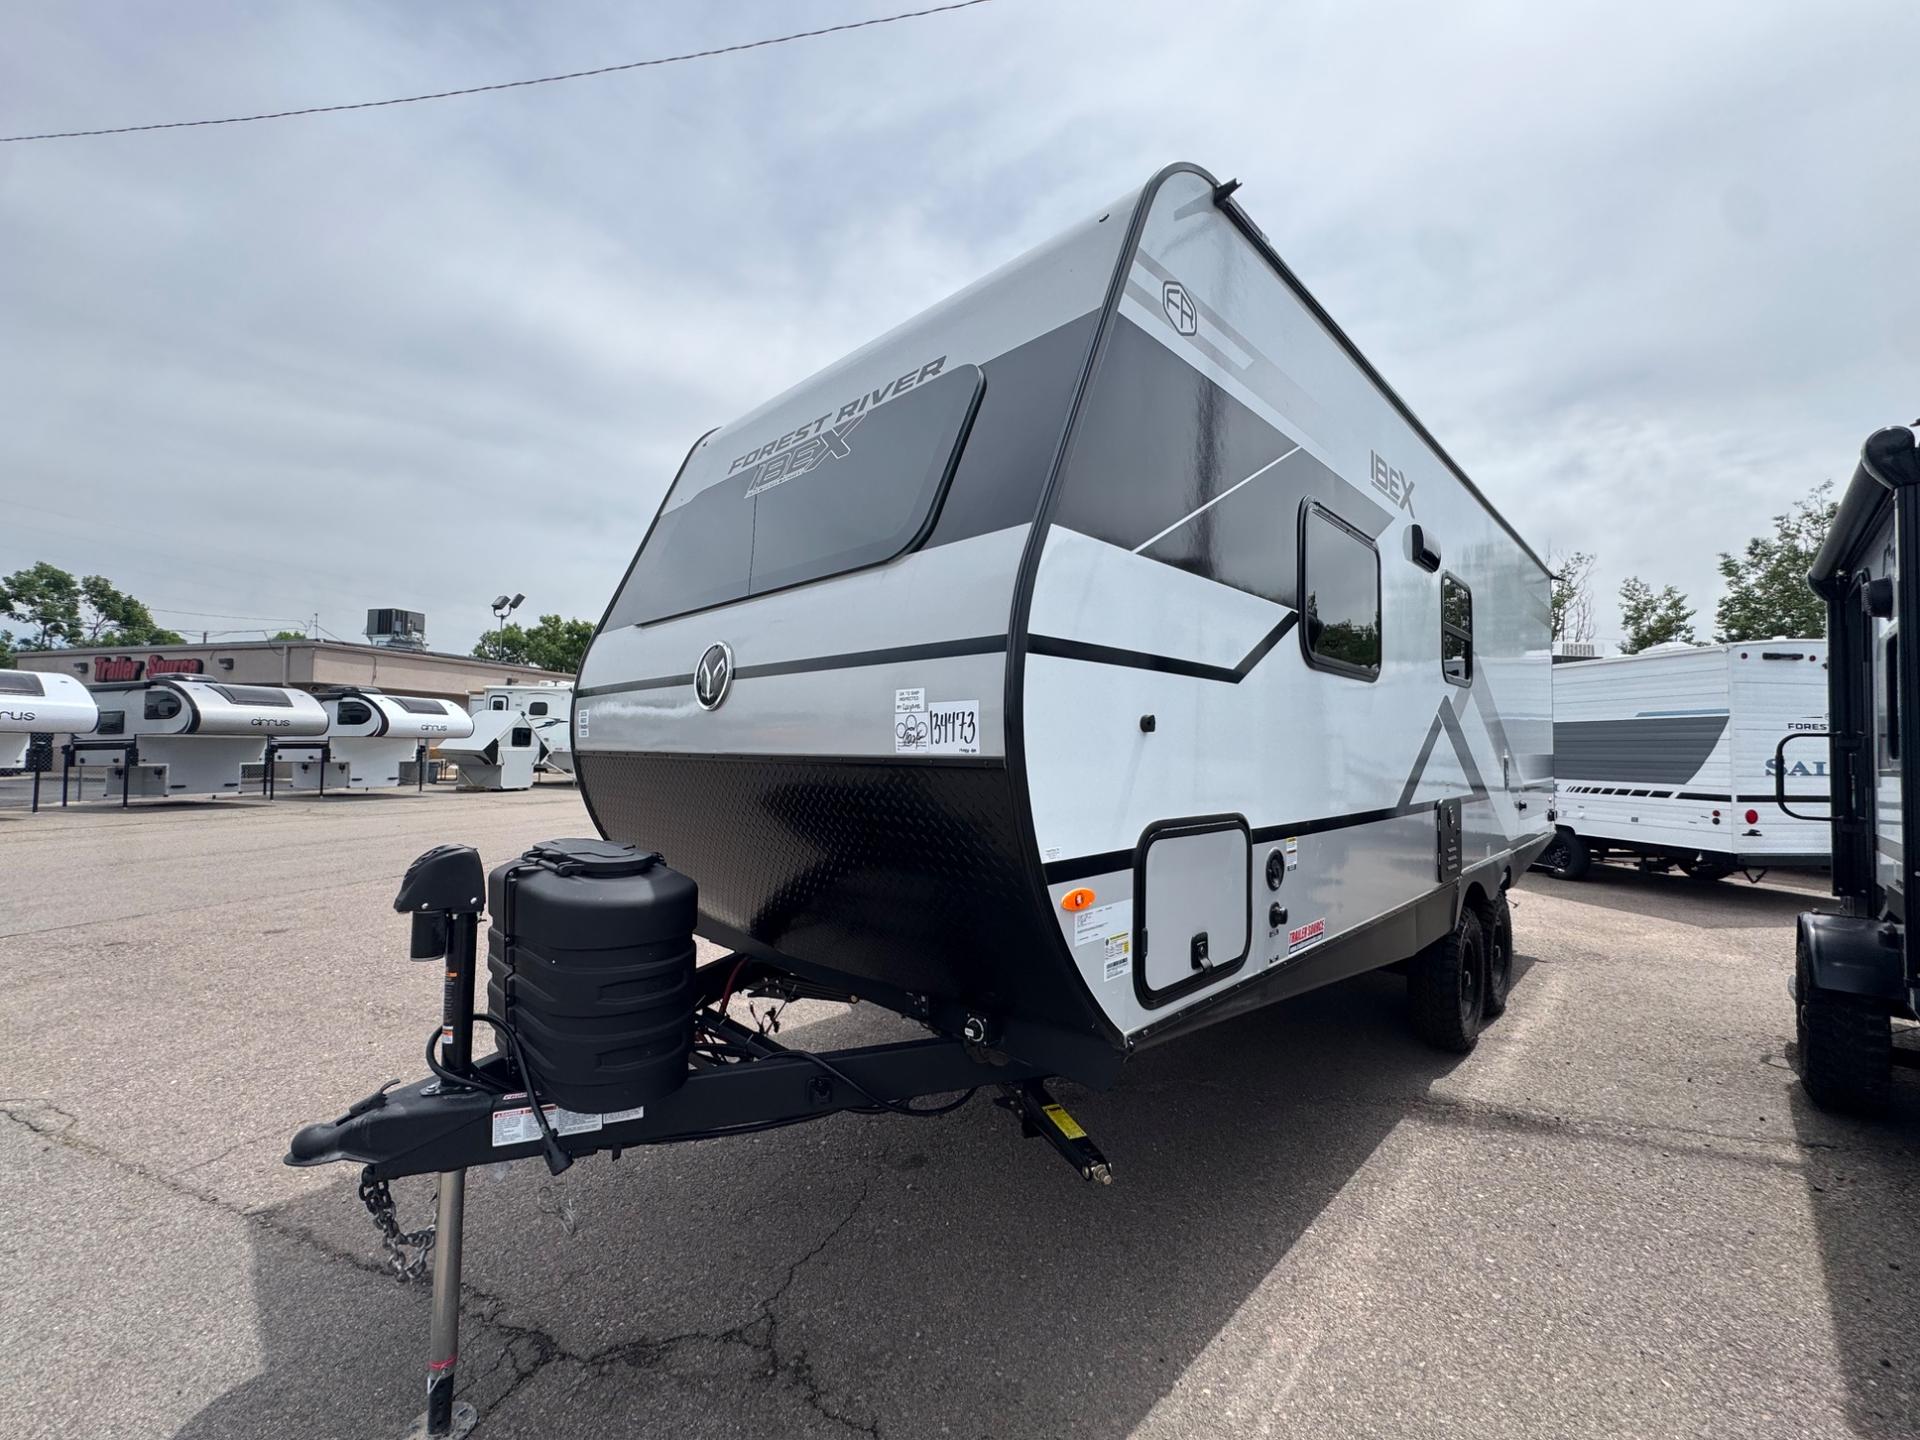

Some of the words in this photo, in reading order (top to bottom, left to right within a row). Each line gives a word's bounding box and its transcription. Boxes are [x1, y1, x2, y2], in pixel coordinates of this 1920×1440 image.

[728, 412, 833, 475] FOREST
[835, 355, 948, 425] RIVER
[745, 411, 867, 498] IBEX
[1370, 449, 1415, 519] IBEX
[95, 656, 144, 682] Trailer
[146, 655, 203, 678] Source
[251, 716, 290, 727] cirrus
[420, 723, 448, 732] cirrus
[929, 710, 976, 745] 134473
[1787, 722, 1829, 731] FORES
